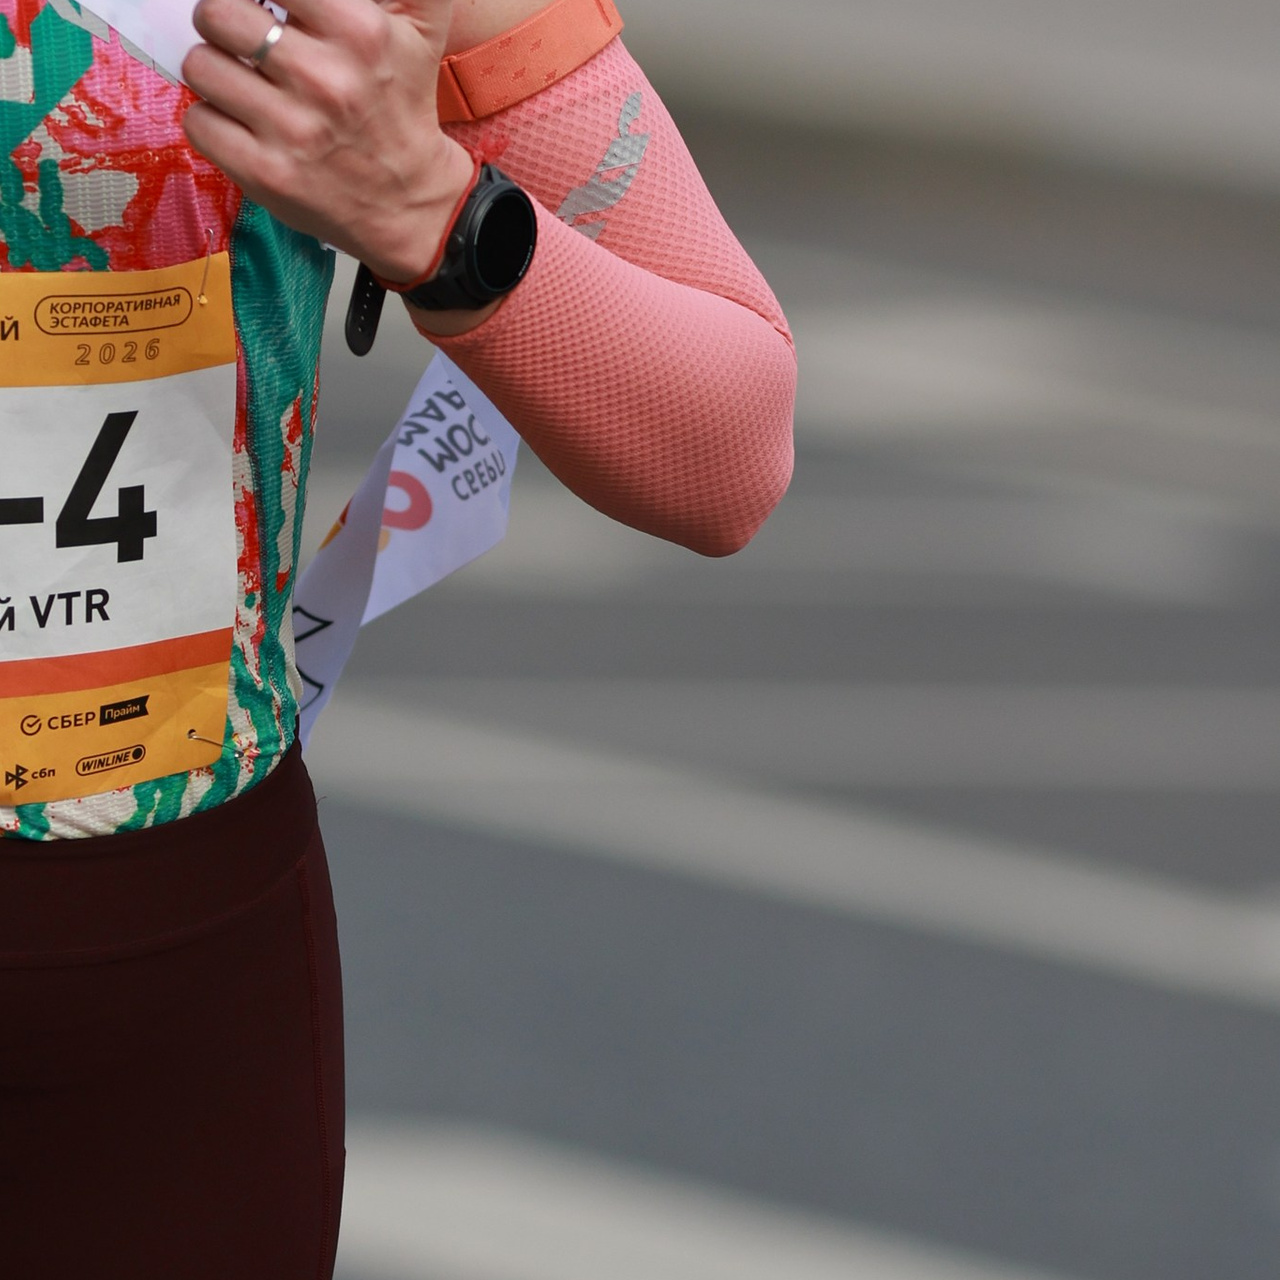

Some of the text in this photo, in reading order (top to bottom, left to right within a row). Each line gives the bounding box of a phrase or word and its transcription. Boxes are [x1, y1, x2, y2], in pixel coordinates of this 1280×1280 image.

[50, 294, 181, 315] КОРПОРАТИВНАЯ
[50, 315, 129, 329] ЭСТАФЕТА
[74, 337, 161, 366] 2026
[29, 588, 110, 628] VTR
[47, 704, 140, 731] СБЕР Прайм
[82, 751, 131, 772] WINLINE
